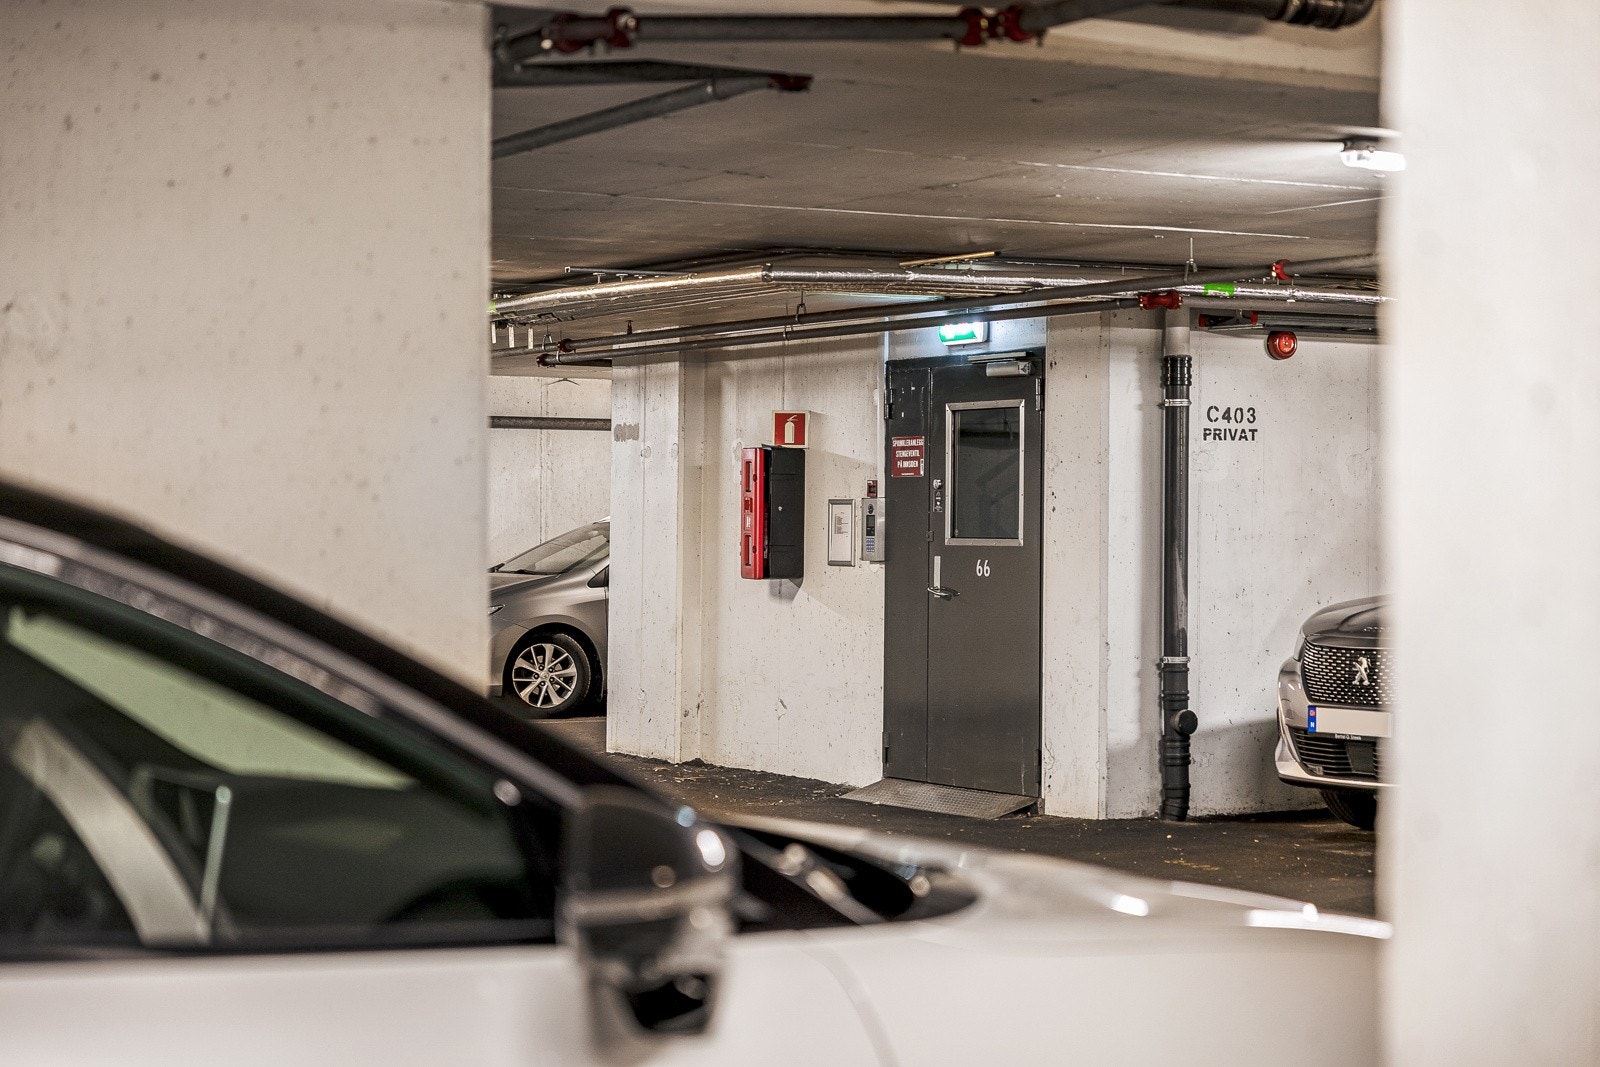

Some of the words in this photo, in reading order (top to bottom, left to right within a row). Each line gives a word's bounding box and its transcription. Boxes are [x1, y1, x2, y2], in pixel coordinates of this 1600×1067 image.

[1206, 405, 1256, 424] C403
[1203, 428, 1258, 441] PRIVAT
[976, 559, 991, 578] 66
